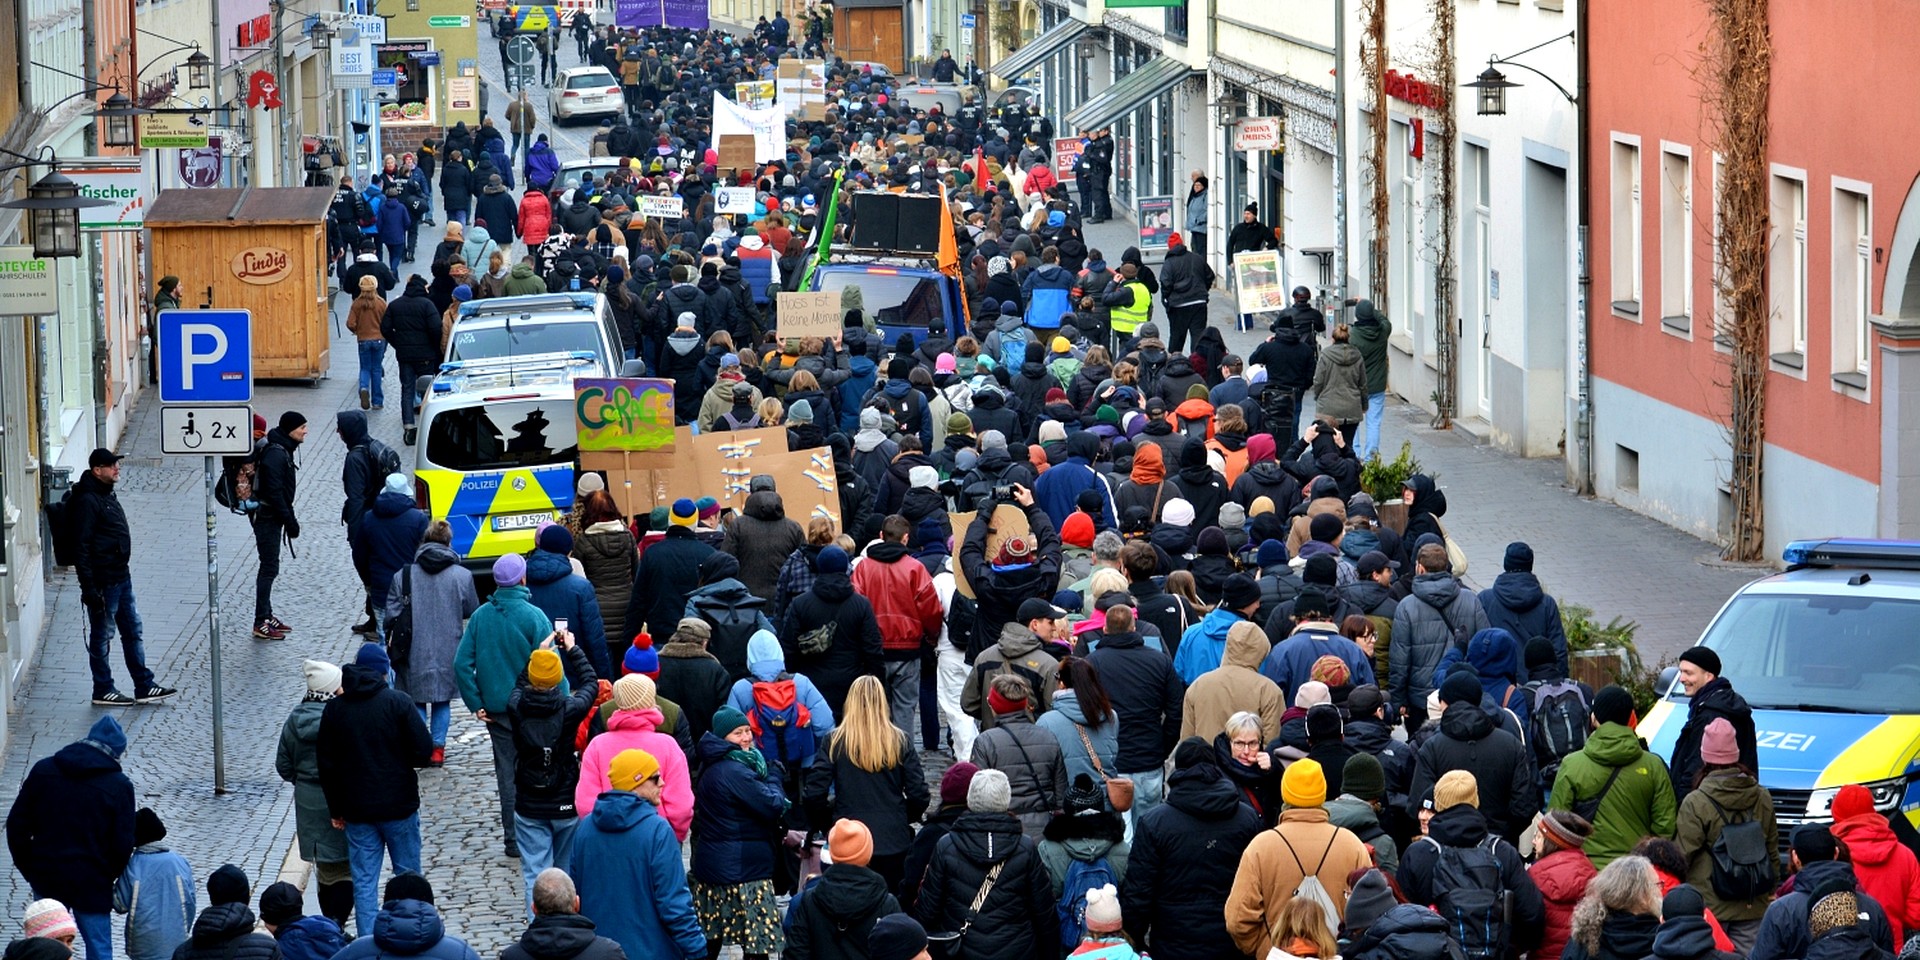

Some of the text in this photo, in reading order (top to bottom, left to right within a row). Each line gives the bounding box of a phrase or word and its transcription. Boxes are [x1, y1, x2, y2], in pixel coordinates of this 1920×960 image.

[340, 53, 361, 63] BEST
[340, 64, 363, 72] SHOES
[1244, 125, 1270, 133] CHINA
[1242, 133, 1272, 141] IMBISS
[1061, 143, 1075, 151] SAL
[1060, 155, 1074, 166] 50
[82, 184, 137, 199] fischer
[238, 252, 287, 278] Lindig
[815, 293, 831, 307] ist
[782, 312, 842, 329] keine Meinung
[181, 324, 228, 390] P
[461, 480, 498, 490] POLIZEI
[498, 518, 509, 527] EF
[516, 516, 528, 526] LP
